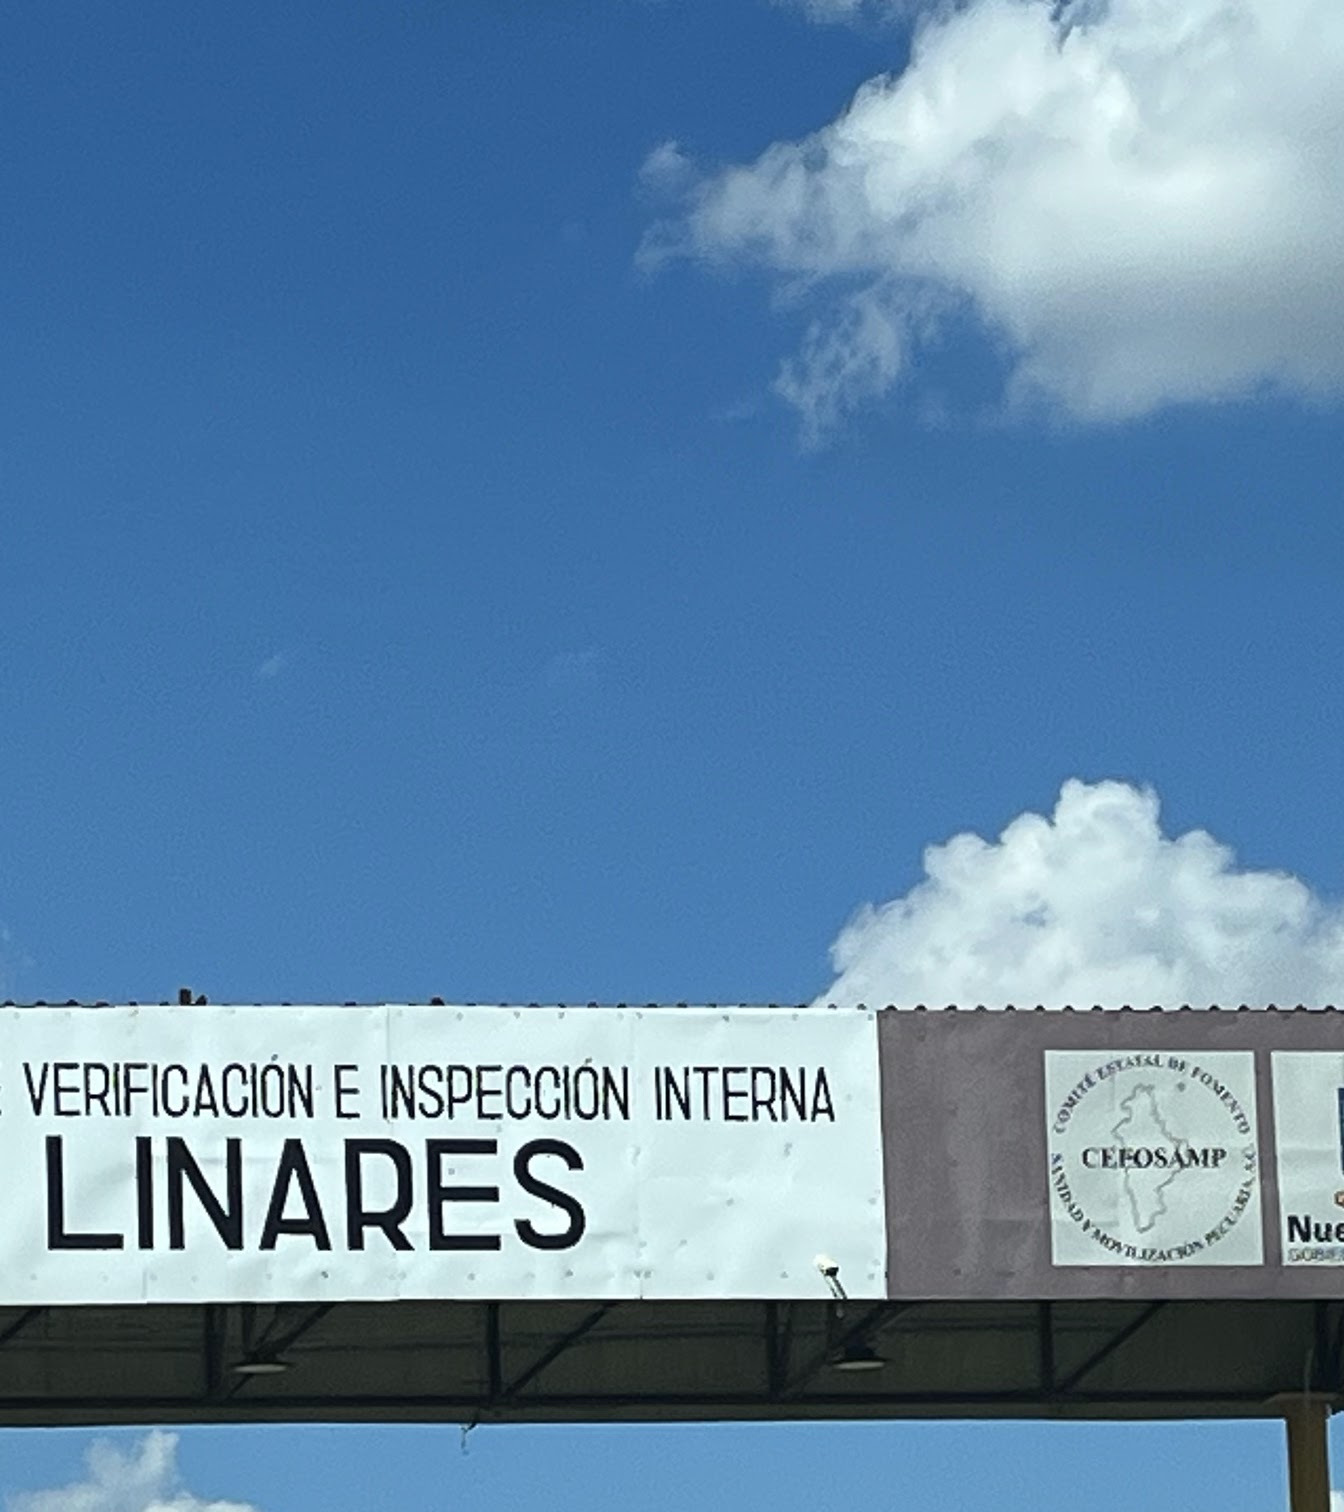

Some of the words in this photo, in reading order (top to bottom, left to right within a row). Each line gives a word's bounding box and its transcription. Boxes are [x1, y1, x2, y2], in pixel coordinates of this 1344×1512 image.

[24, 1054, 314, 1118] VERIFICACIÓN
[335, 1064, 360, 1119] E
[381, 1057, 630, 1121] INSPECCIÓN
[656, 1066, 836, 1122] INTERNA
[1097, 1054, 1164, 1080] ESTATAL
[1167, 1057, 1187, 1072] DE
[1191, 1067, 1250, 1134] FOMENTO
[45, 1135, 586, 1251] LINARES
[1082, 1147, 1227, 1169] CEFOSAMP
